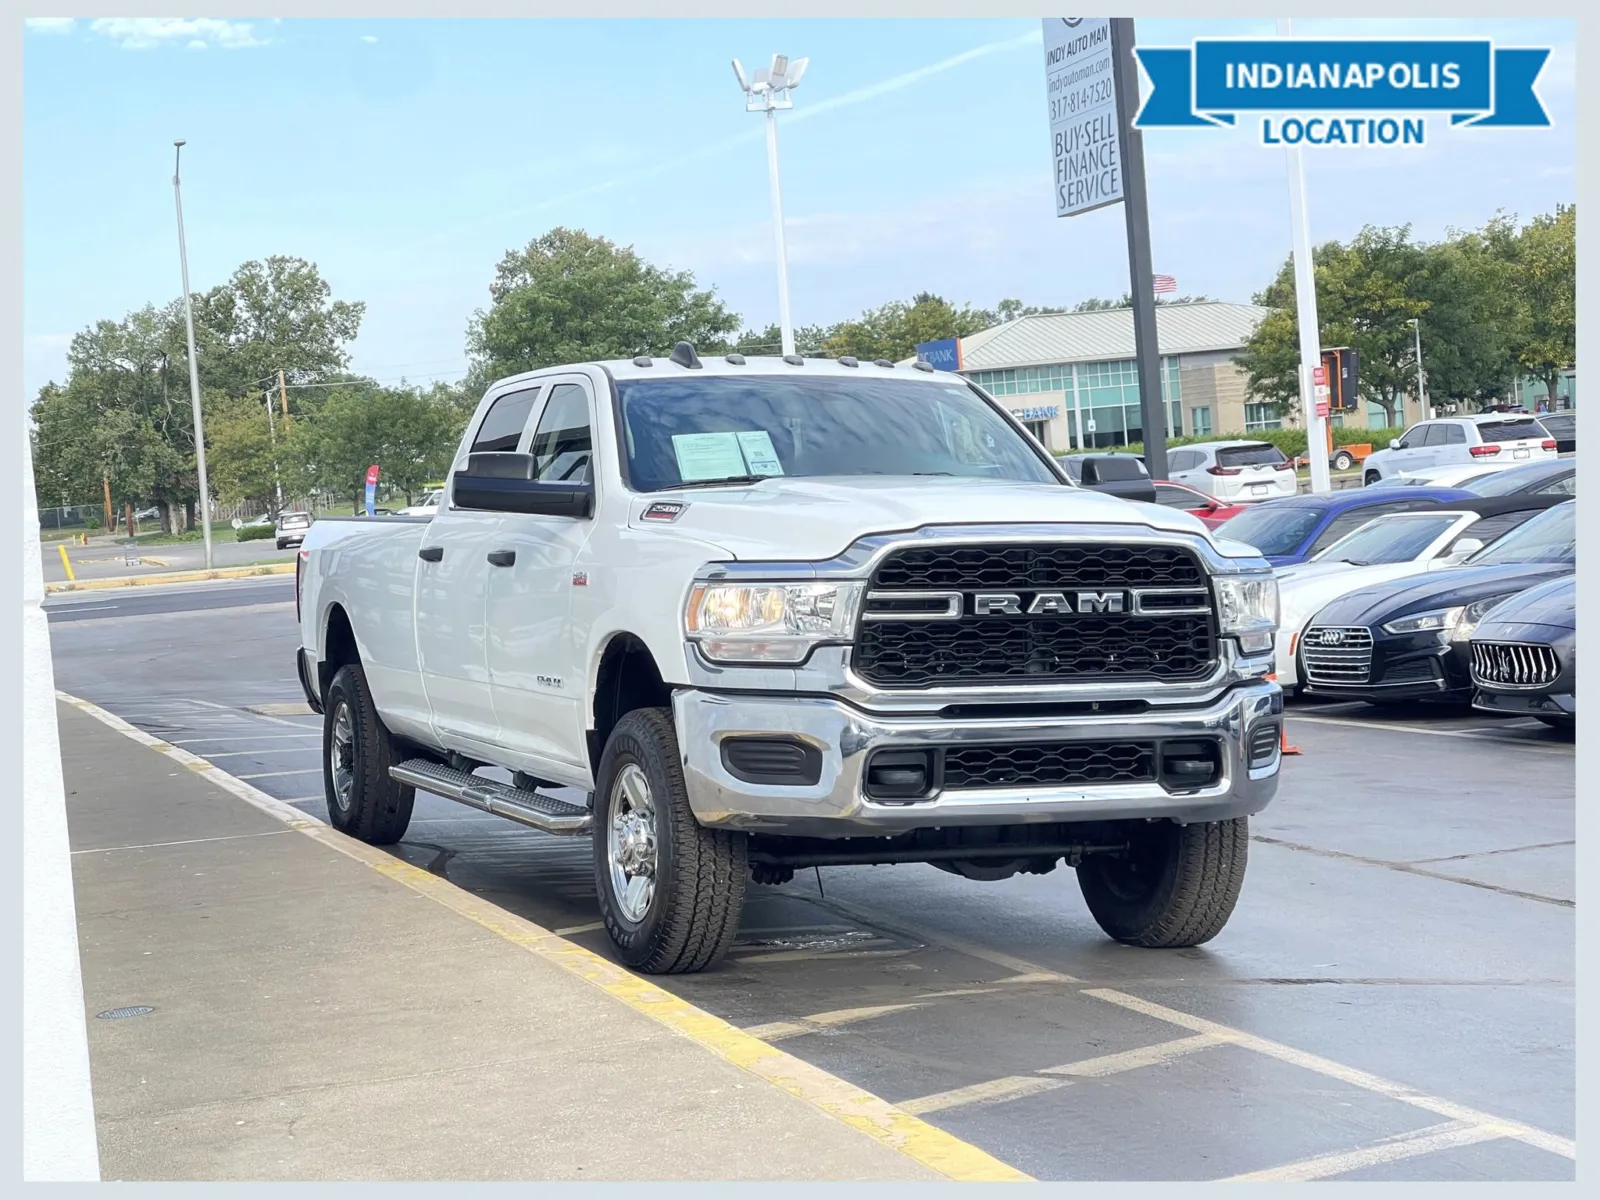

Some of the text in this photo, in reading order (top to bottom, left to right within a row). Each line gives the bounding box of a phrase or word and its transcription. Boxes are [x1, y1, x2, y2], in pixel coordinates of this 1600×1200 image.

[1047, 25, 1108, 66] INDY AUTO MAN
[1048, 56, 1111, 95] indyautoman.com
[1057, 140, 1117, 184] FINANCE
[1059, 168, 1119, 210] SERVICE
[974, 591, 1126, 615] RAM
